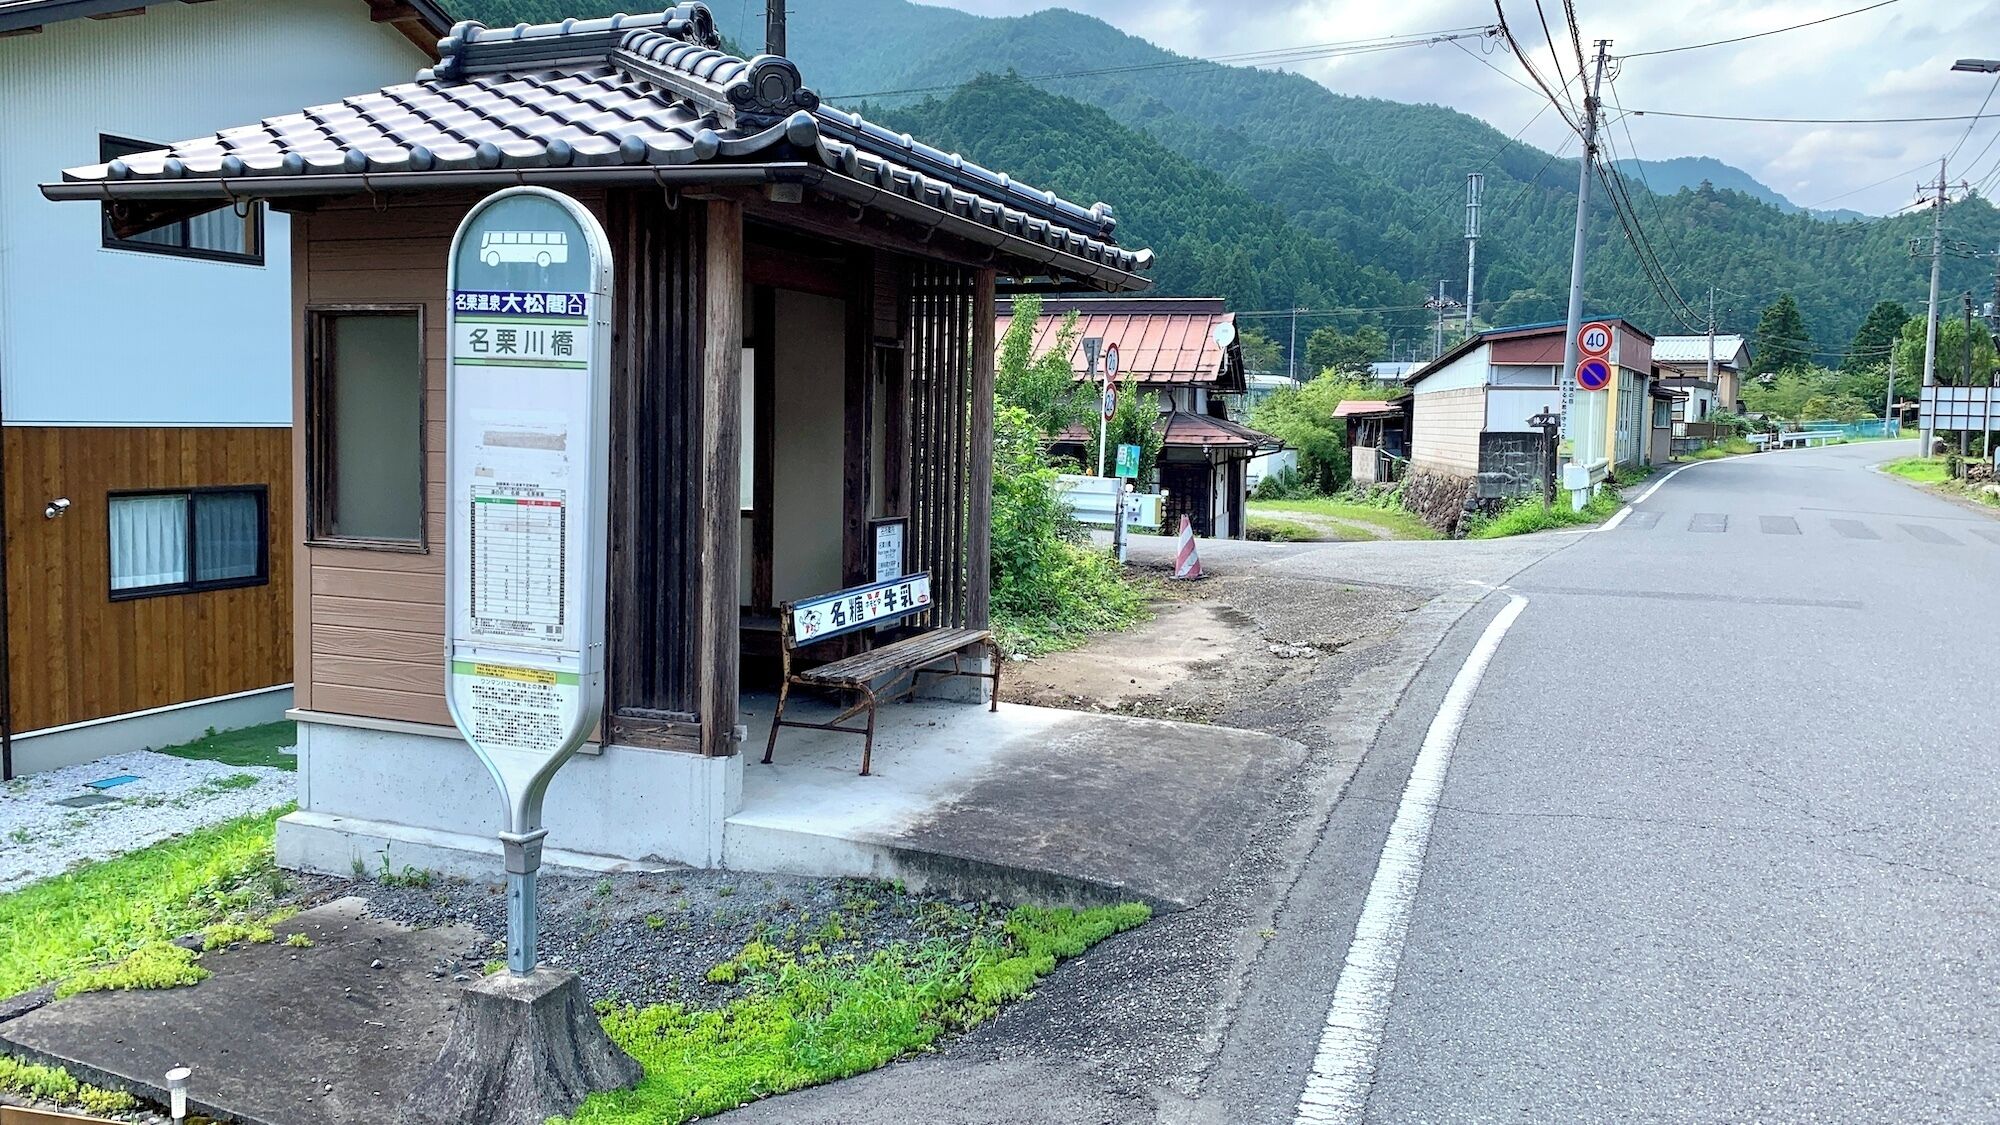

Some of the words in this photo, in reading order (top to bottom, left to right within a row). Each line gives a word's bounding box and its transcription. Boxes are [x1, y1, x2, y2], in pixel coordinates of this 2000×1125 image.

[469, 328, 573, 357] 名栗川橋
[1586, 333, 1605, 347] 40
[831, 596, 863, 626] 名糖
[884, 585, 914, 612] 牛乳
